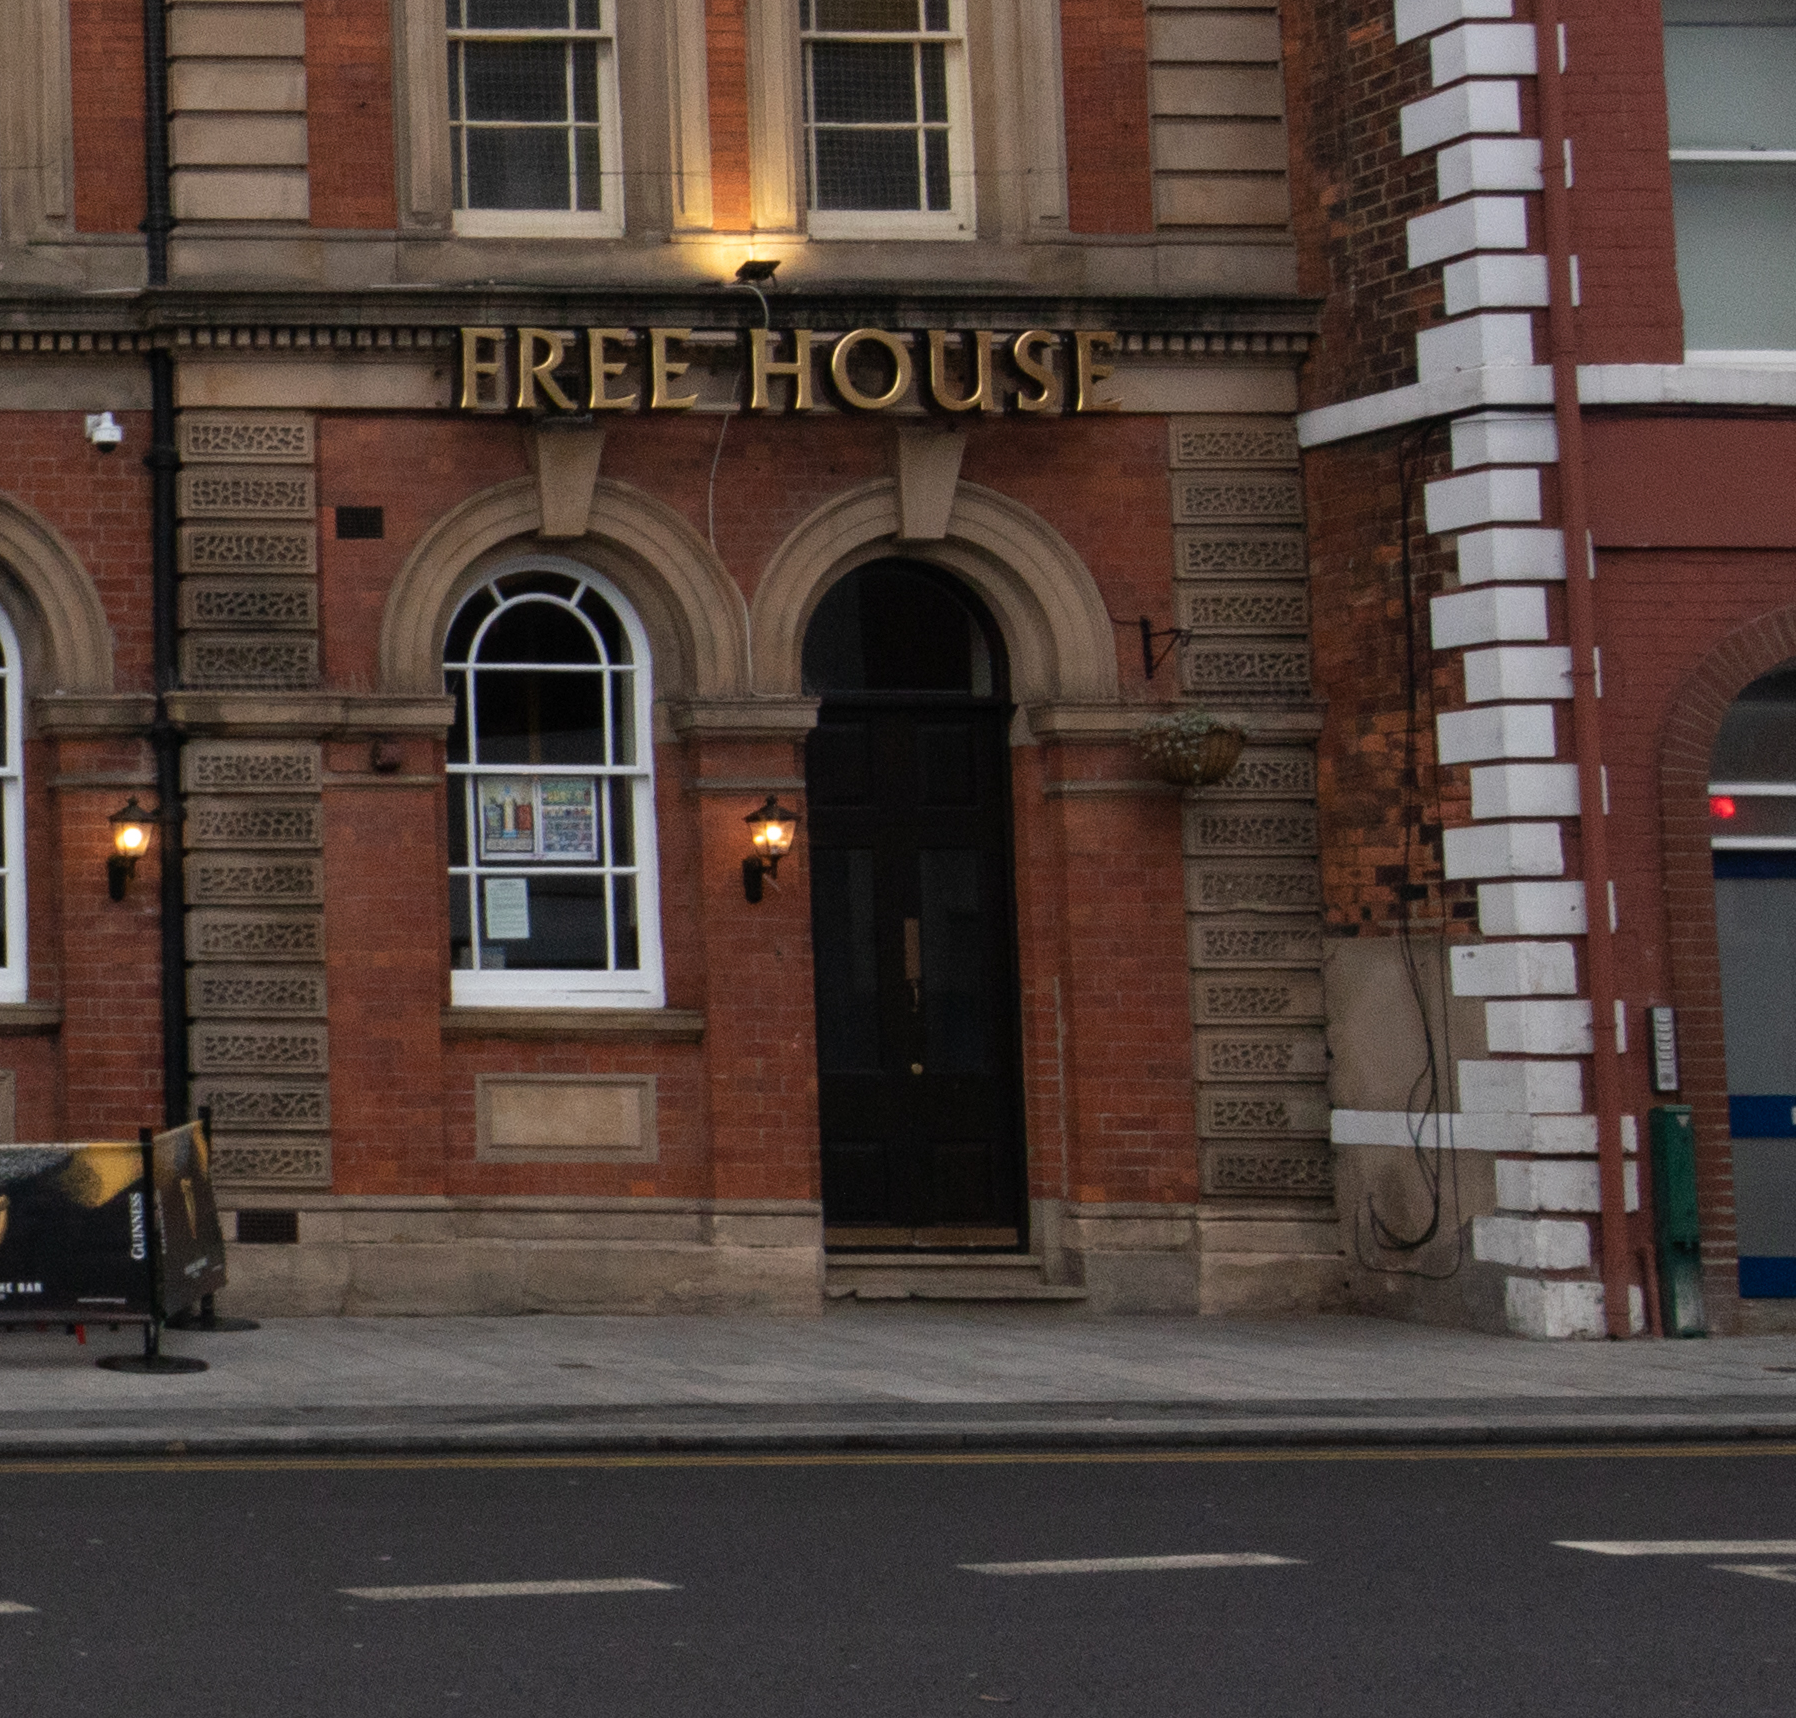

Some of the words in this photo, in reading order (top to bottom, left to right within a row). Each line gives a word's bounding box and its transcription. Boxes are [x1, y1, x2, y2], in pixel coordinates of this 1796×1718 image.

[460, 326, 700, 410] FREE
[749, 327, 1124, 412] HOUSE
[130, 1192, 145, 1260] GUINNESS
[17, 1281, 43, 1293] BAR
